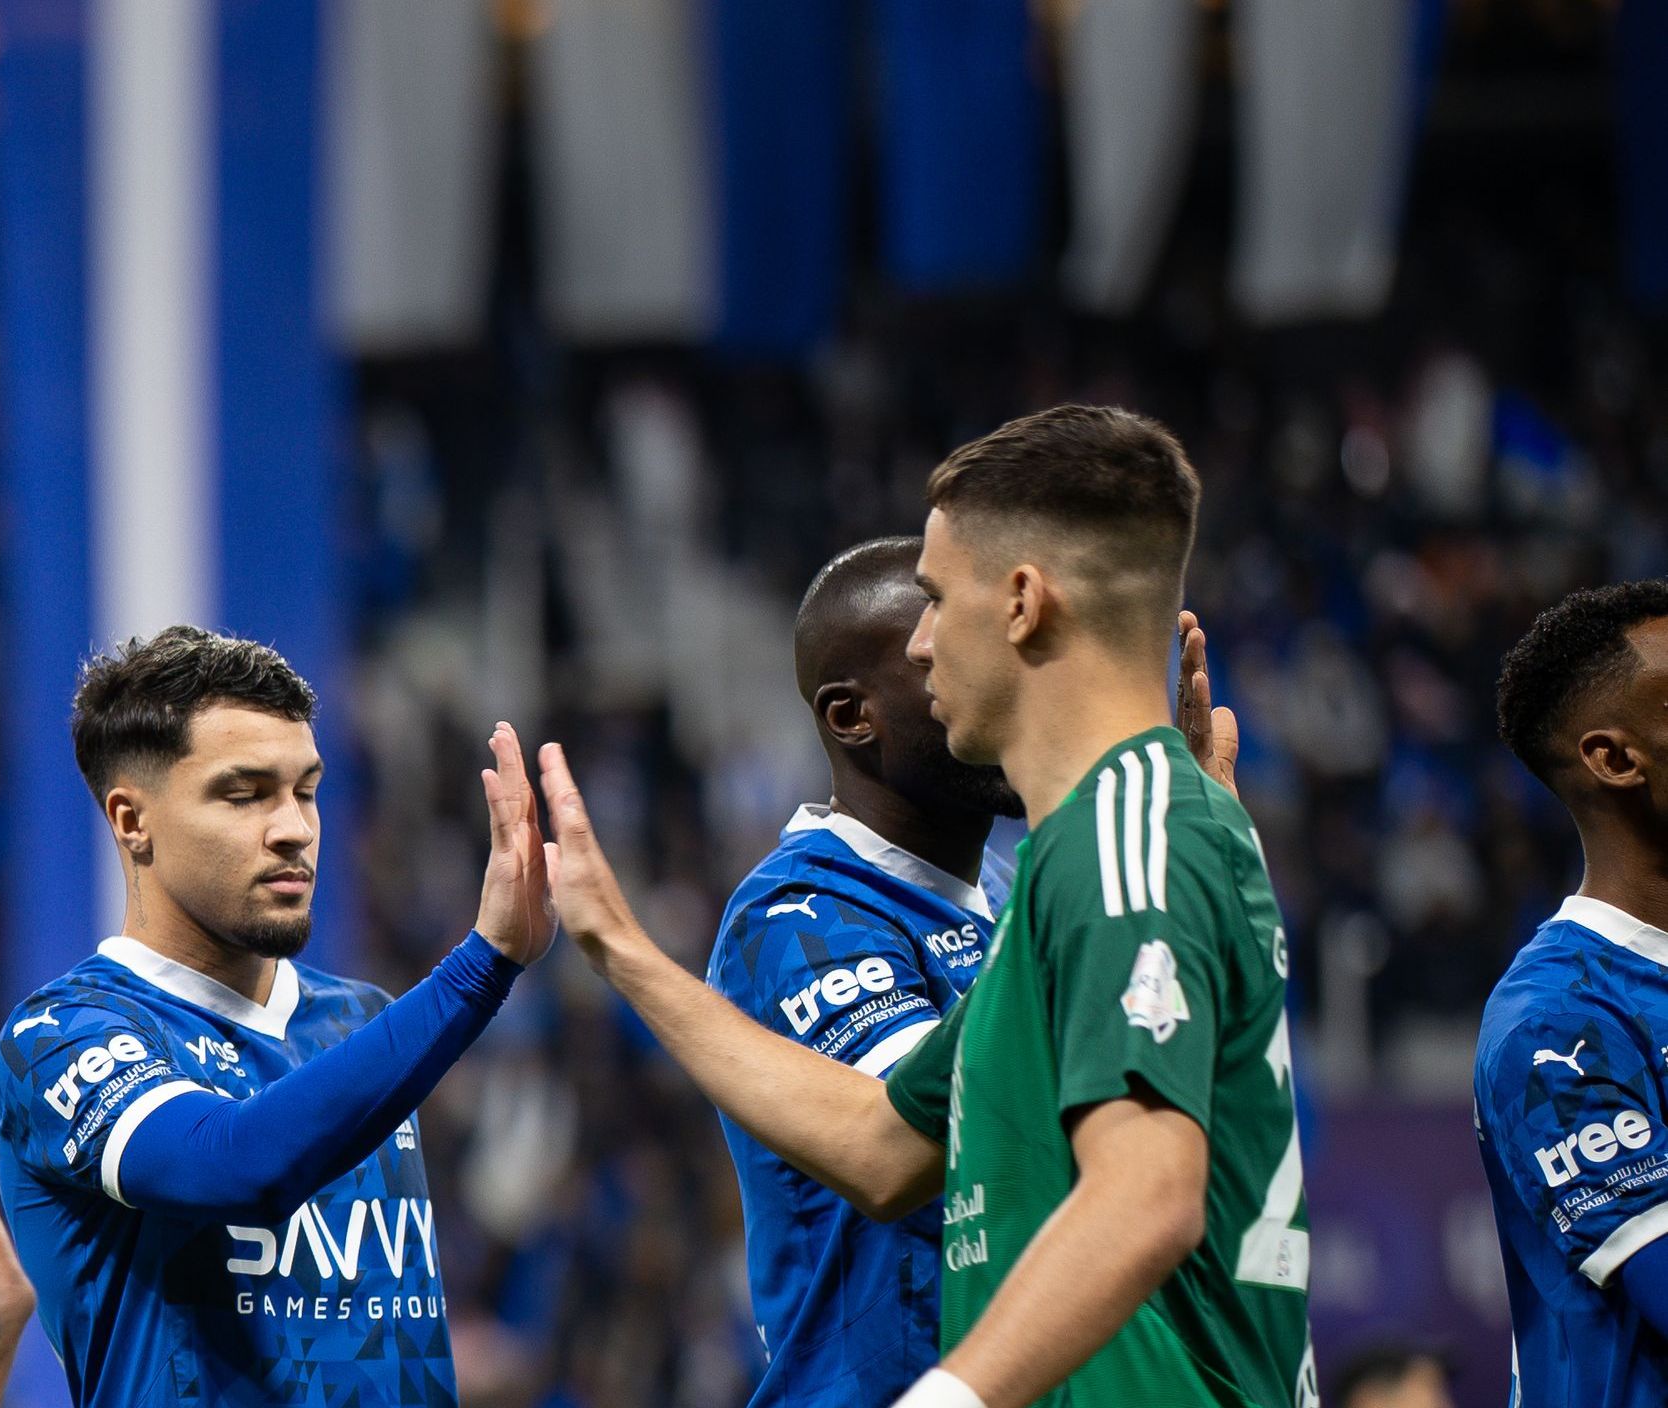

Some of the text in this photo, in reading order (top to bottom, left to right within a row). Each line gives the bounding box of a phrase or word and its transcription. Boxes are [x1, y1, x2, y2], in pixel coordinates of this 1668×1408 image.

[779, 957, 895, 1036] tree
[827, 1030, 855, 1058] NABIL
[44, 1034, 148, 1120] tree
[1534, 1110, 1651, 1187] tree
[1612, 1165, 1668, 1198] INVESTMEN
[237, 1292, 352, 1319] GAMES
